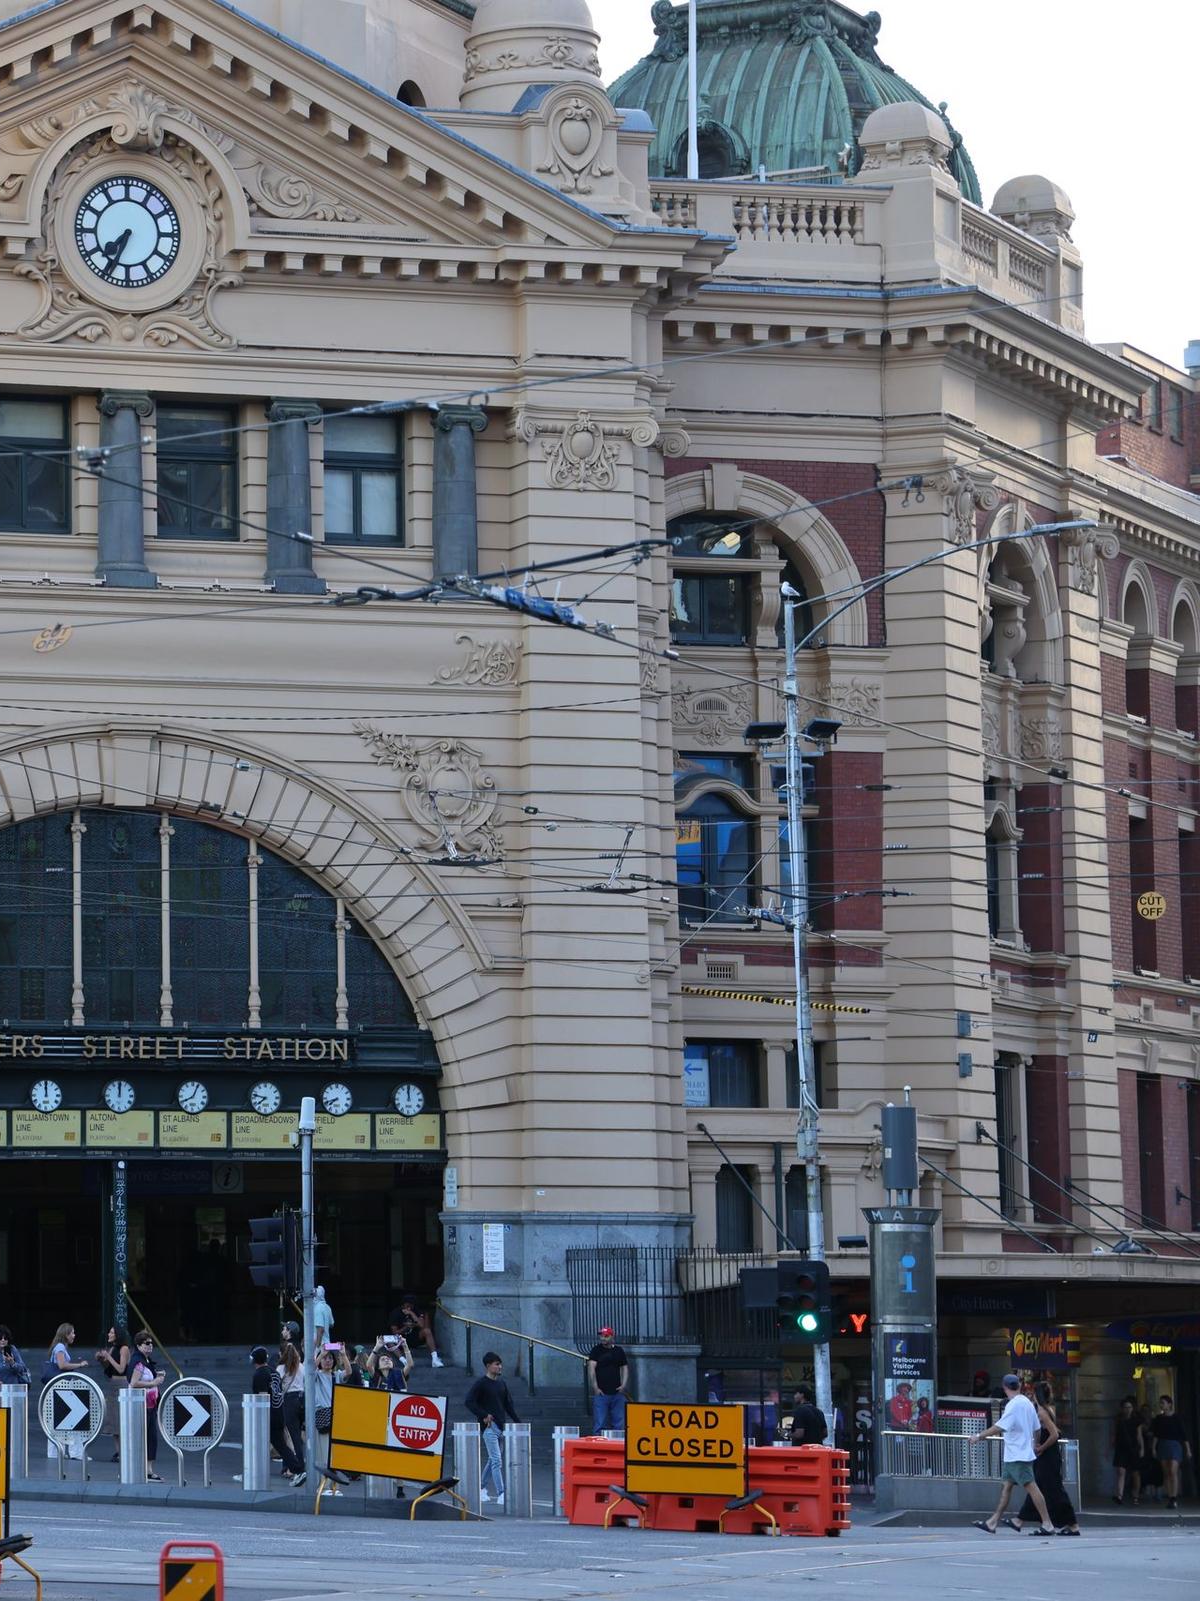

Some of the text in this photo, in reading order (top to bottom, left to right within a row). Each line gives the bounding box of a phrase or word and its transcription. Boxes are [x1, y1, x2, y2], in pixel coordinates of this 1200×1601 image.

[1140, 896, 1162, 905] CUT
[1141, 908, 1163, 916] OFF
[83, 1036, 188, 1058] STREET
[223, 1037, 348, 1060] STATION
[90, 1113, 117, 1121] ALTONA
[380, 1117, 414, 1125] WERRIBEE
[410, 1405, 426, 1416] NO
[651, 1409, 719, 1429] ROAD
[399, 1428, 434, 1441] ENTRY
[637, 1437, 734, 1458] CLOSED
